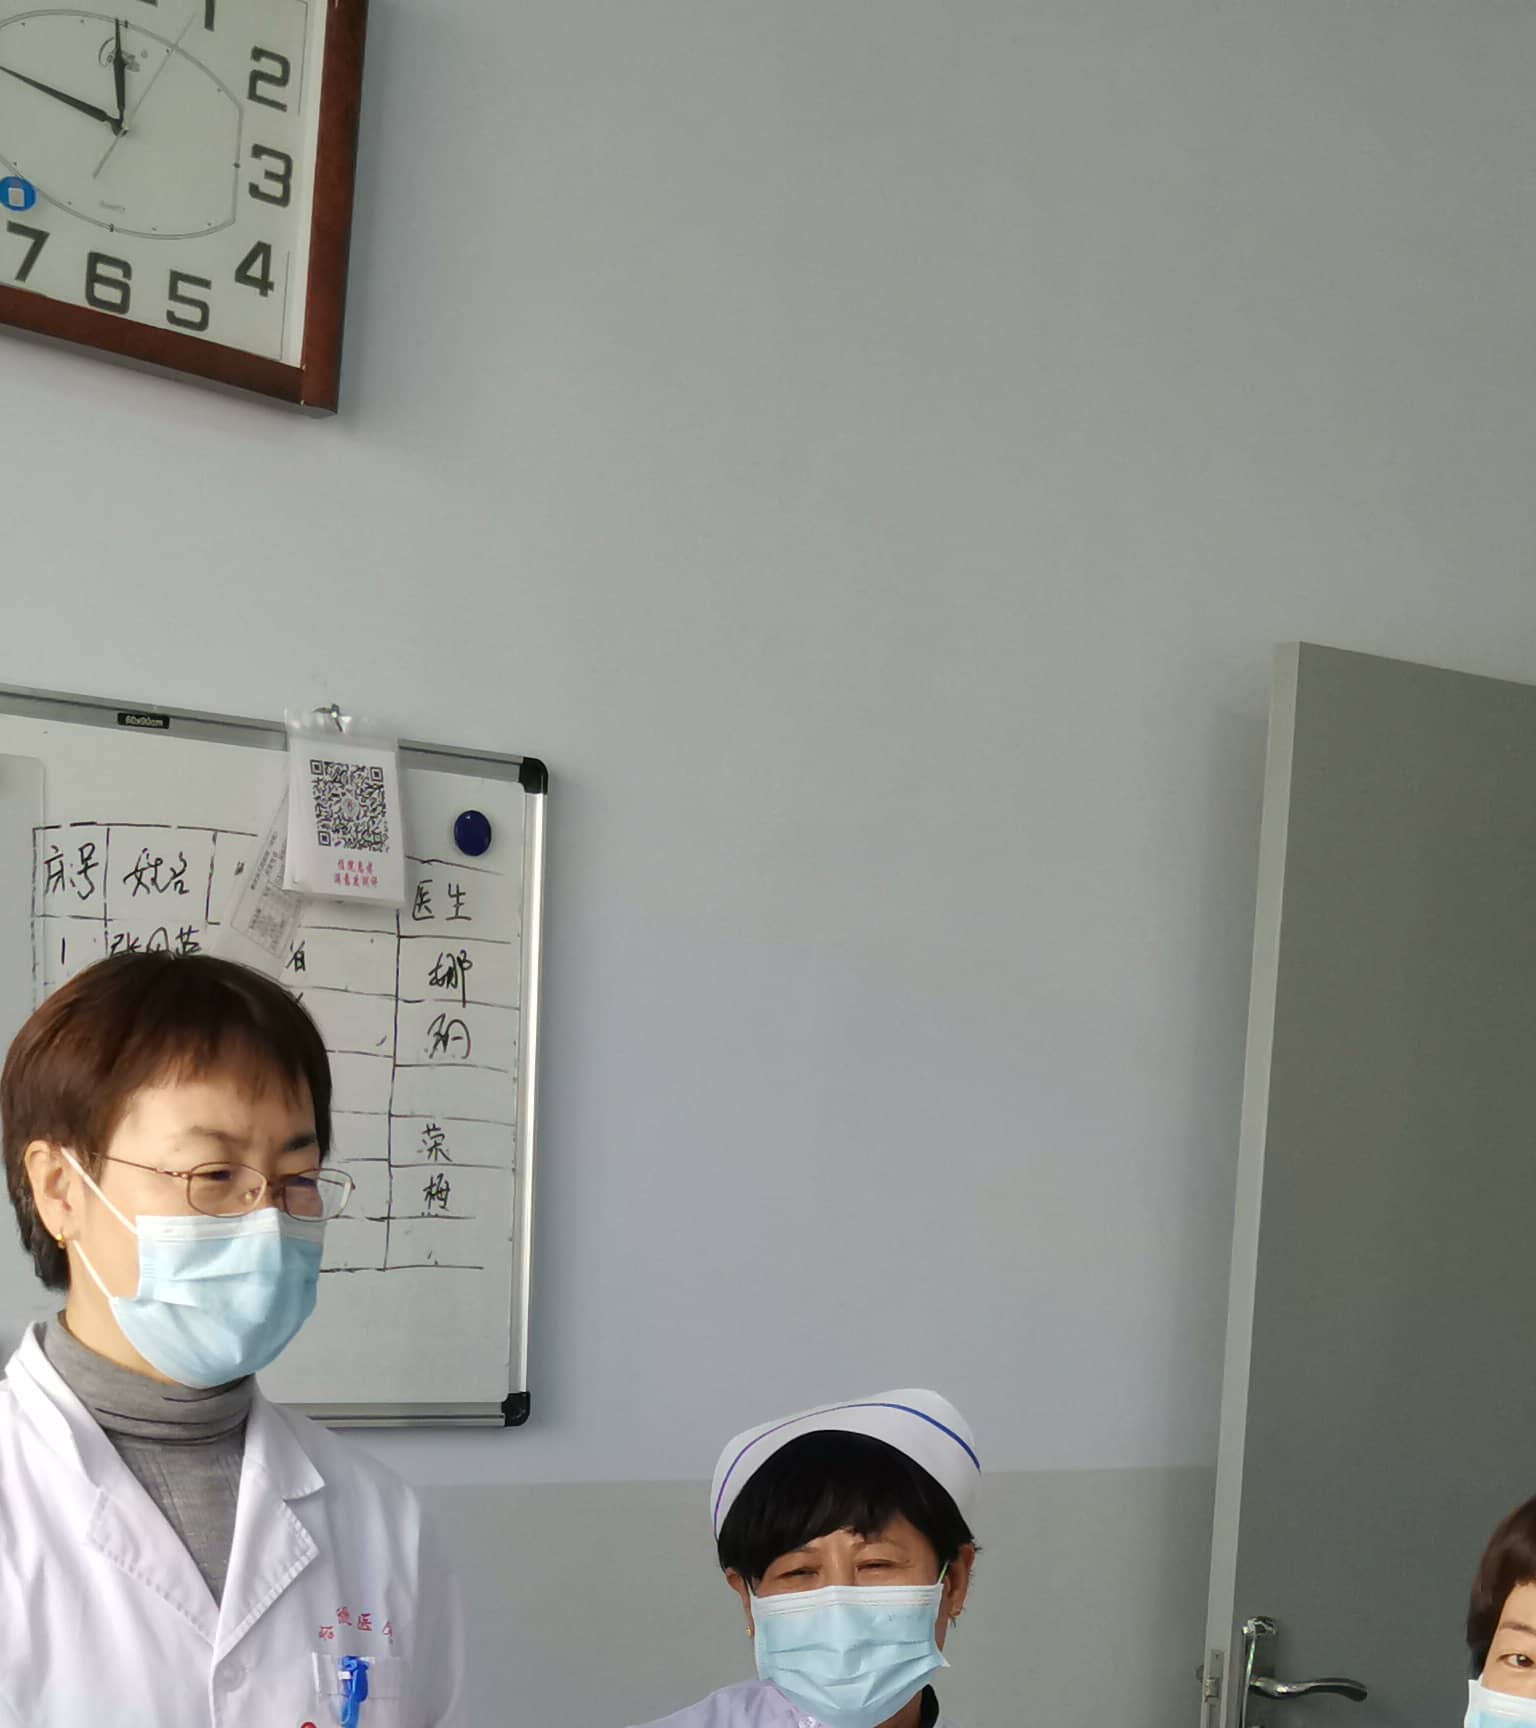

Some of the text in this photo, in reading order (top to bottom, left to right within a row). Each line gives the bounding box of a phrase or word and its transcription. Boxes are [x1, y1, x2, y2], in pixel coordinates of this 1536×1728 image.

[248, 45, 290, 113] 2
[248, 143, 293, 208] 3
[6, 221, 51, 283] 7
[234, 240, 275, 298] 4
[85, 251, 132, 316] 6
[166, 269, 212, 332] 5
[44, 842, 99, 900] 床号
[122, 847, 190, 897] 姓名
[412, 879, 472, 922] 医生
